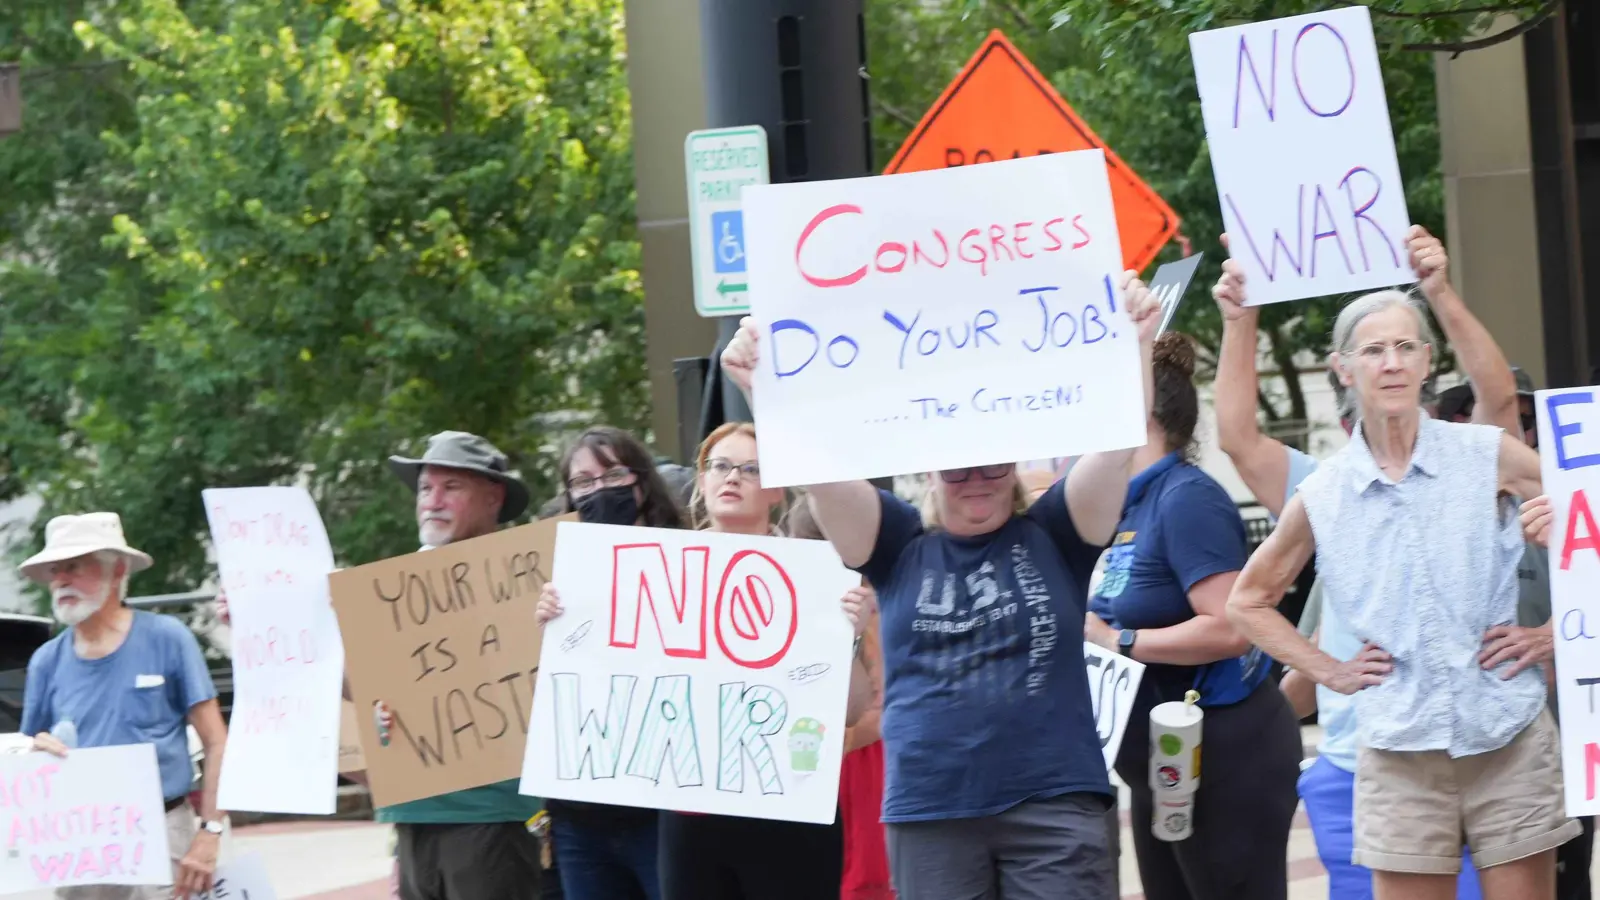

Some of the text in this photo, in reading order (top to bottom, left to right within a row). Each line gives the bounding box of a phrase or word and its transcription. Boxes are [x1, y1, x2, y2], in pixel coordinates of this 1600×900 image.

[1232, 21, 1355, 129] NO
[795, 203, 1092, 287] CONGRESS
[1224, 166, 1401, 283] WAR
[883, 308, 1001, 370] YOUR
[1018, 273, 1119, 353] JOB!
[372, 549, 552, 633] YOUR WAR
[608, 542, 798, 669] NO
[410, 624, 501, 683] IS A
[392, 665, 540, 769] WAST
[550, 672, 789, 797] WAR
[7, 803, 147, 849] ANOTHER
[30, 840, 145, 884] WAR!
